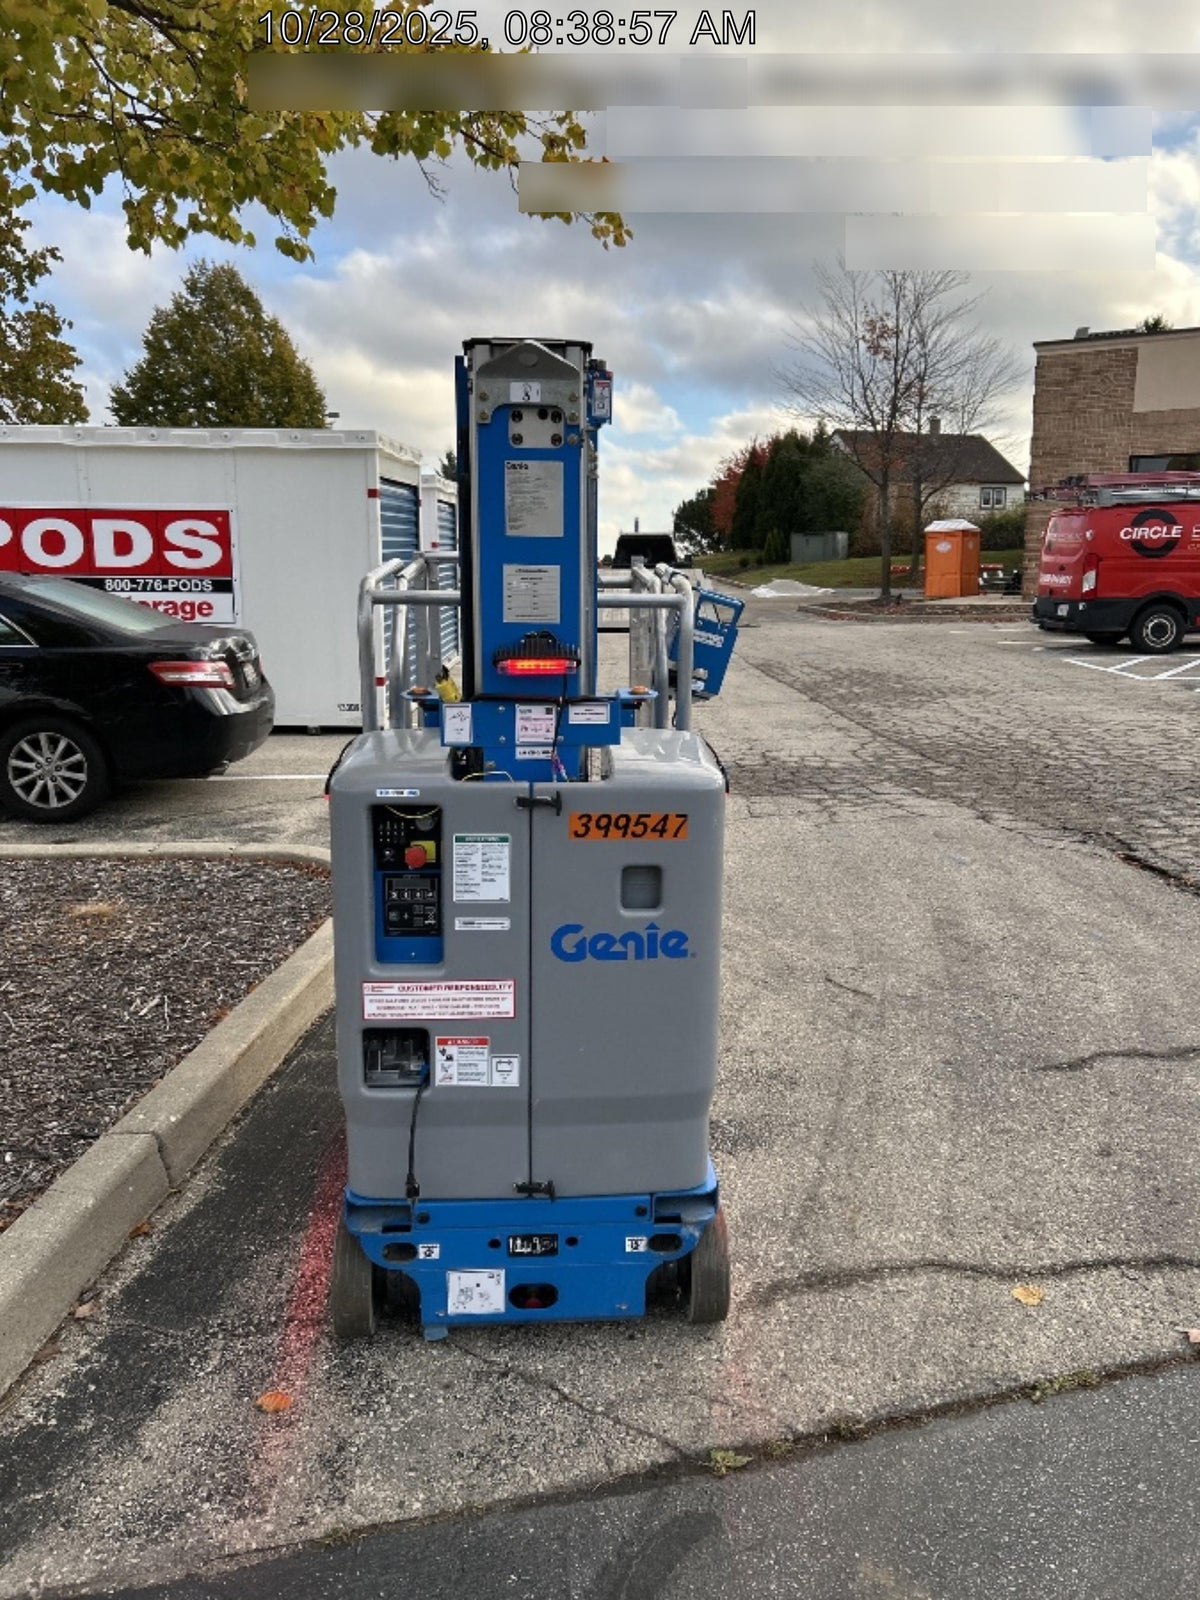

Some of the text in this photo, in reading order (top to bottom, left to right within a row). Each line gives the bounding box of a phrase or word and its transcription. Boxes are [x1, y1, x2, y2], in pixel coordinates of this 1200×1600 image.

[0, 517, 223, 569] ODS
[1119, 525, 1184, 540] CIRCLE
[105, 579, 213, 592] 800-776-PODS
[574, 813, 688, 838] 399547
[550, 921, 690, 963] Genie
